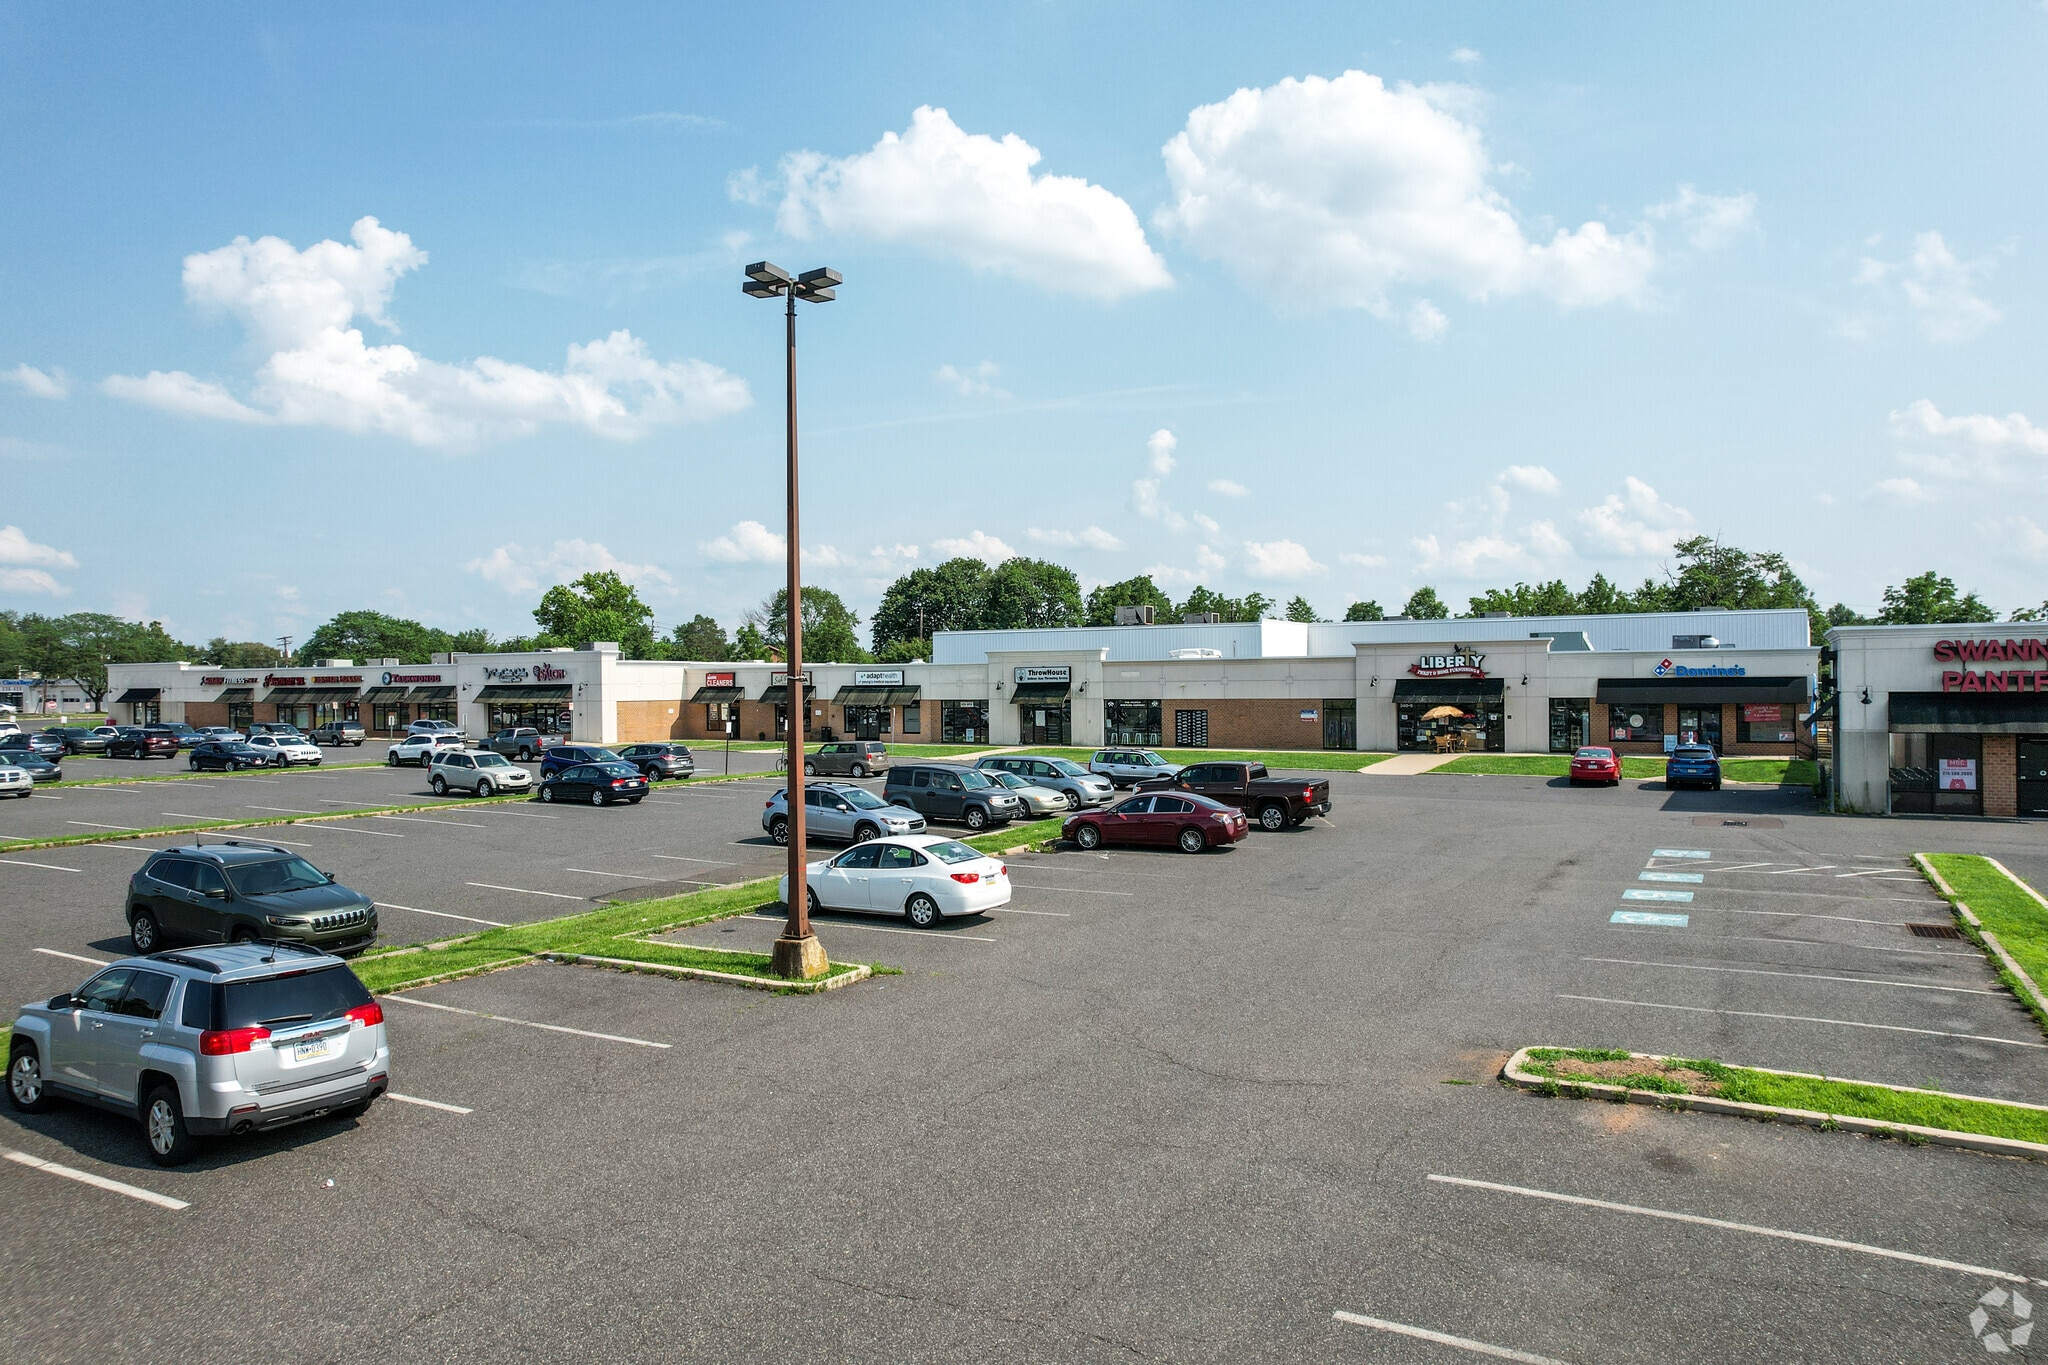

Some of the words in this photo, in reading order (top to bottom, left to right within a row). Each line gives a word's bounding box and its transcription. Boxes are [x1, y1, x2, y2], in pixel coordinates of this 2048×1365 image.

[1420, 647, 1485, 669] LIBERTY
[1934, 638, 2048, 662] SWANN
[1675, 664, 1746, 677] Domino's
[706, 679, 734, 687] CLEANERS
